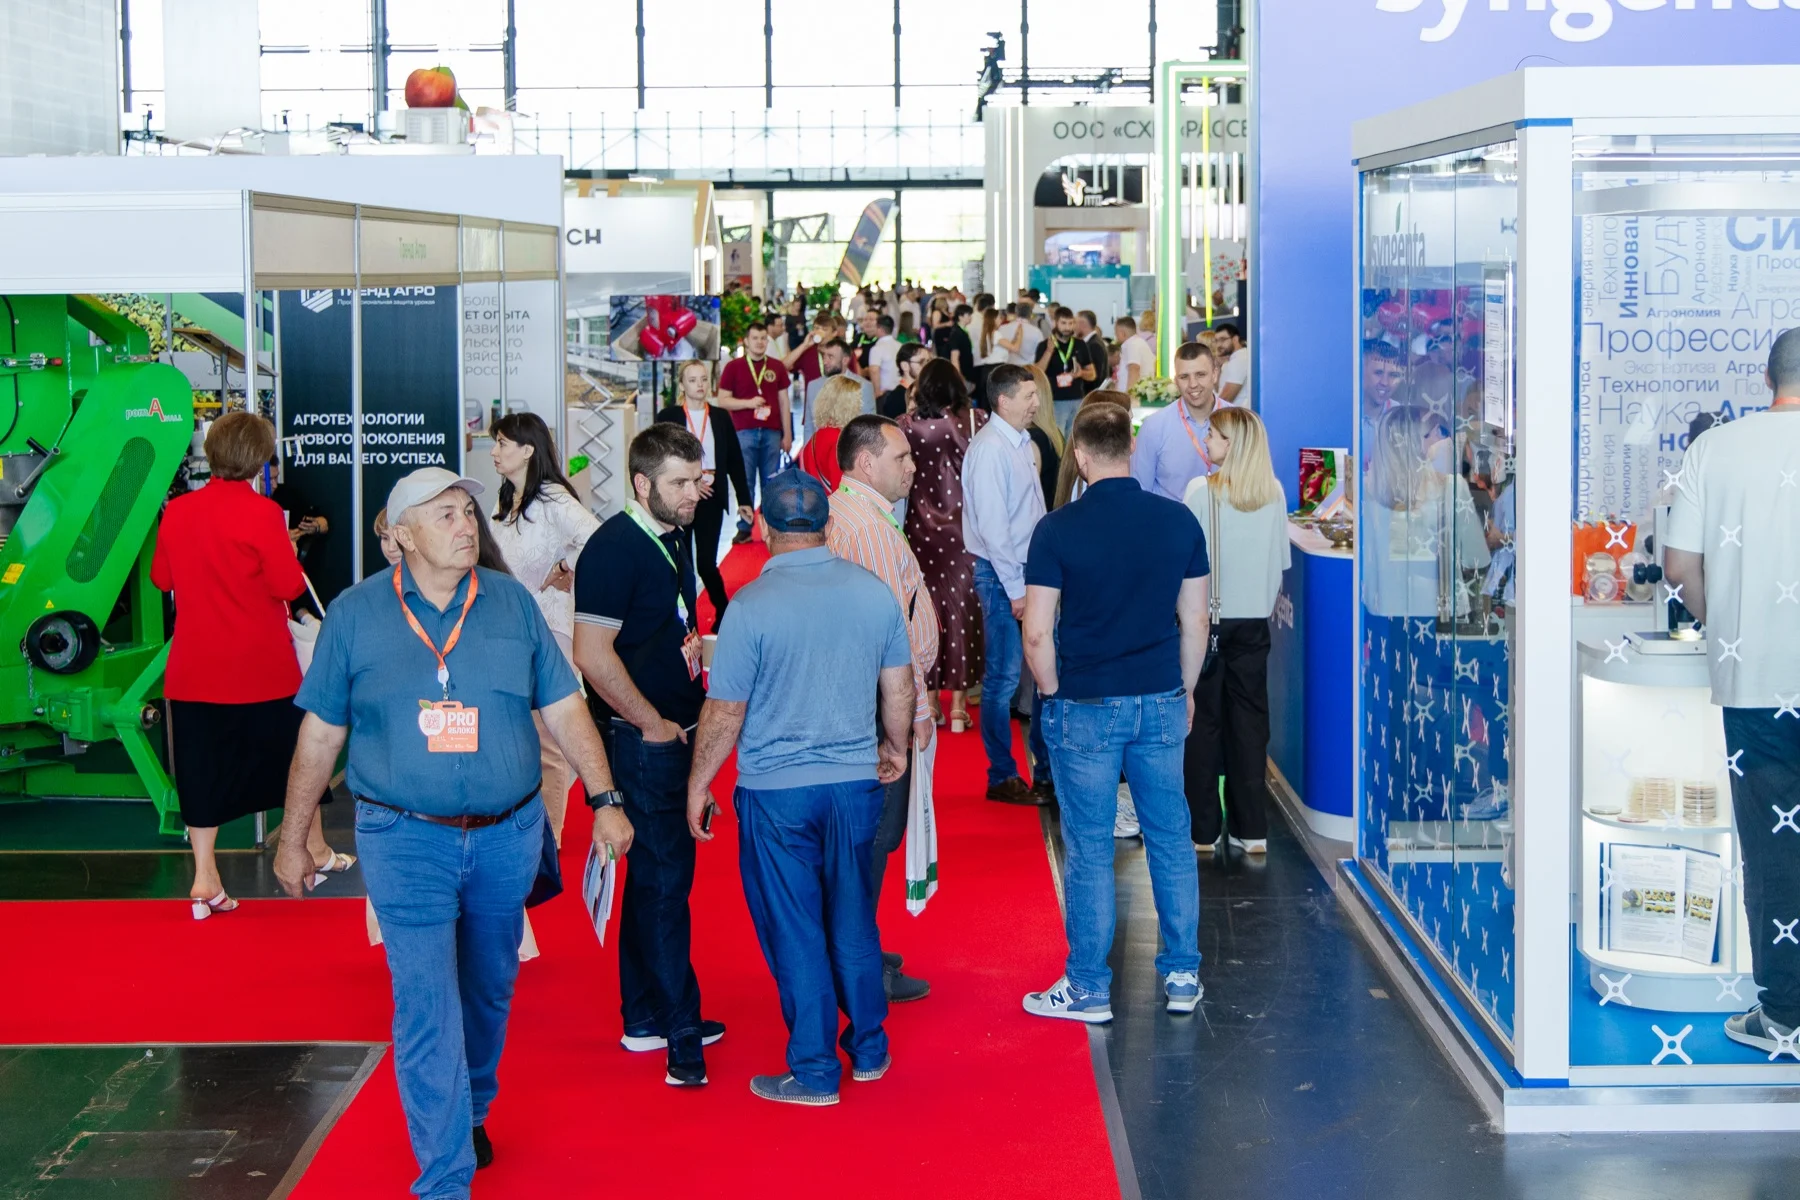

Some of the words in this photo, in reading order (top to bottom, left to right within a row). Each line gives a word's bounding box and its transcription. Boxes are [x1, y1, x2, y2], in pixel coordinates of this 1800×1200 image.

[1113, 120, 1155, 139] «СХ
[1728, 254, 1740, 292] Наука
[393, 285, 436, 297] АГРО
[1646, 307, 1721, 320] Агрономия
[1598, 376, 1720, 393] Технологии
[1598, 394, 1701, 432] Наука
[390, 452, 446, 465] УСПЕХА
[447, 711, 476, 726] PRO
[447, 727, 476, 735] ЯБЛОКО
[1050, 990, 1066, 1008] N
